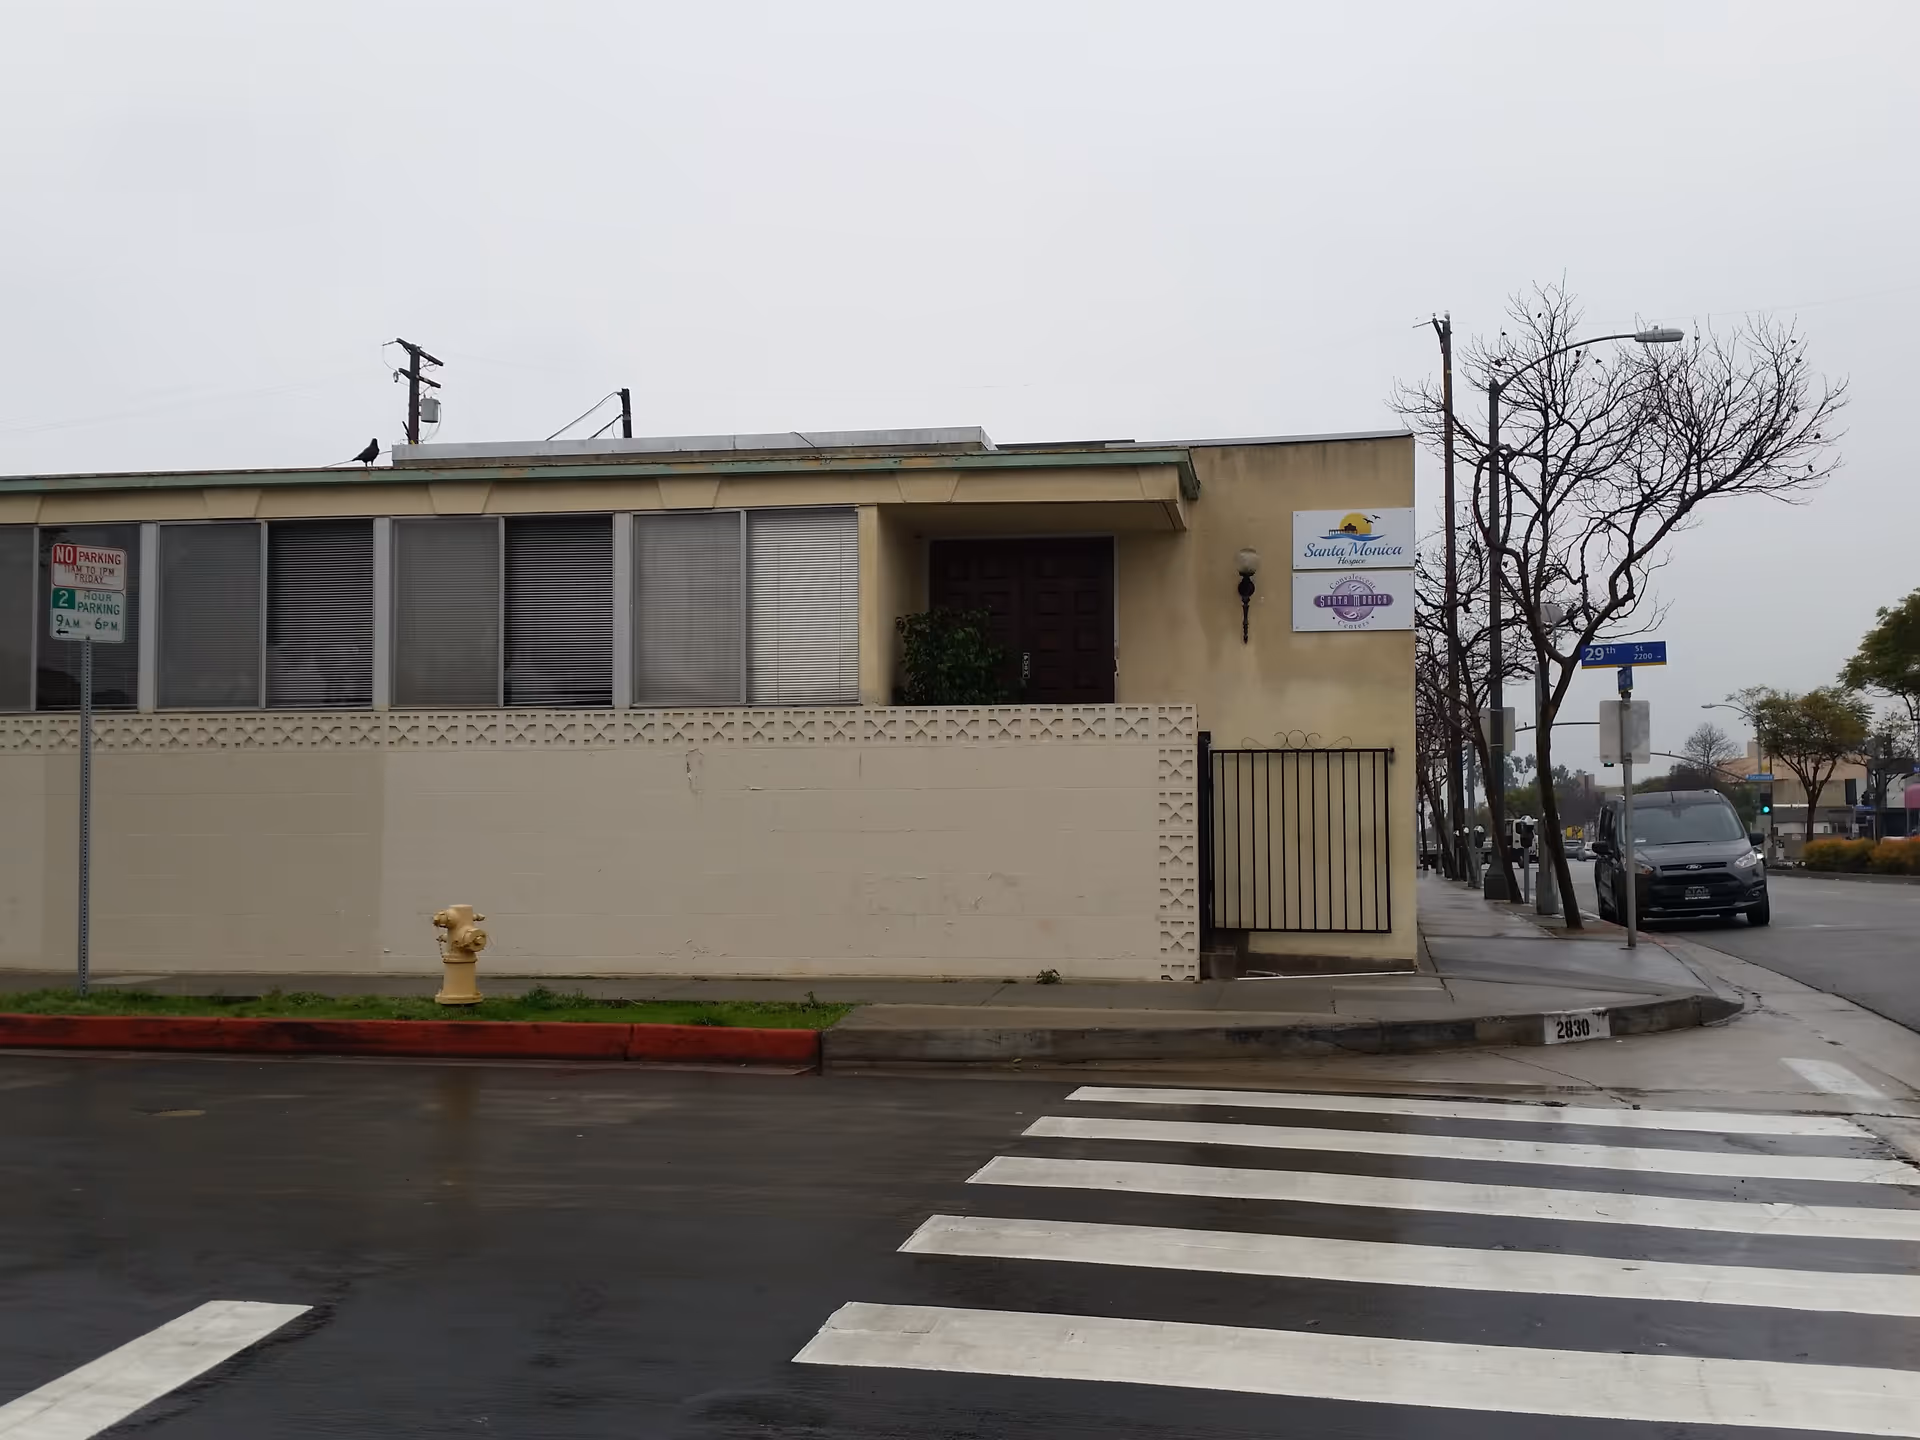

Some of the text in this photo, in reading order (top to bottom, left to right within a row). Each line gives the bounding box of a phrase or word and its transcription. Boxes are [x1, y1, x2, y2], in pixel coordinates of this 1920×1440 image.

[56, 546, 121, 565] NO PARKING
[1304, 542, 1403, 557] Santa Monica
[1337, 557, 1367, 566] Hospice
[64, 564, 115, 577] 11AM TO 1PM
[74, 573, 104, 585] FRIDAY
[1329, 574, 1377, 590] Convalescent
[58, 590, 112, 607] 2 HOUR
[77, 602, 120, 616] PARKING
[1337, 620, 1370, 630] Centers
[1585, 646, 1616, 661] 29th
[1556, 1018, 1590, 1039] 2830
